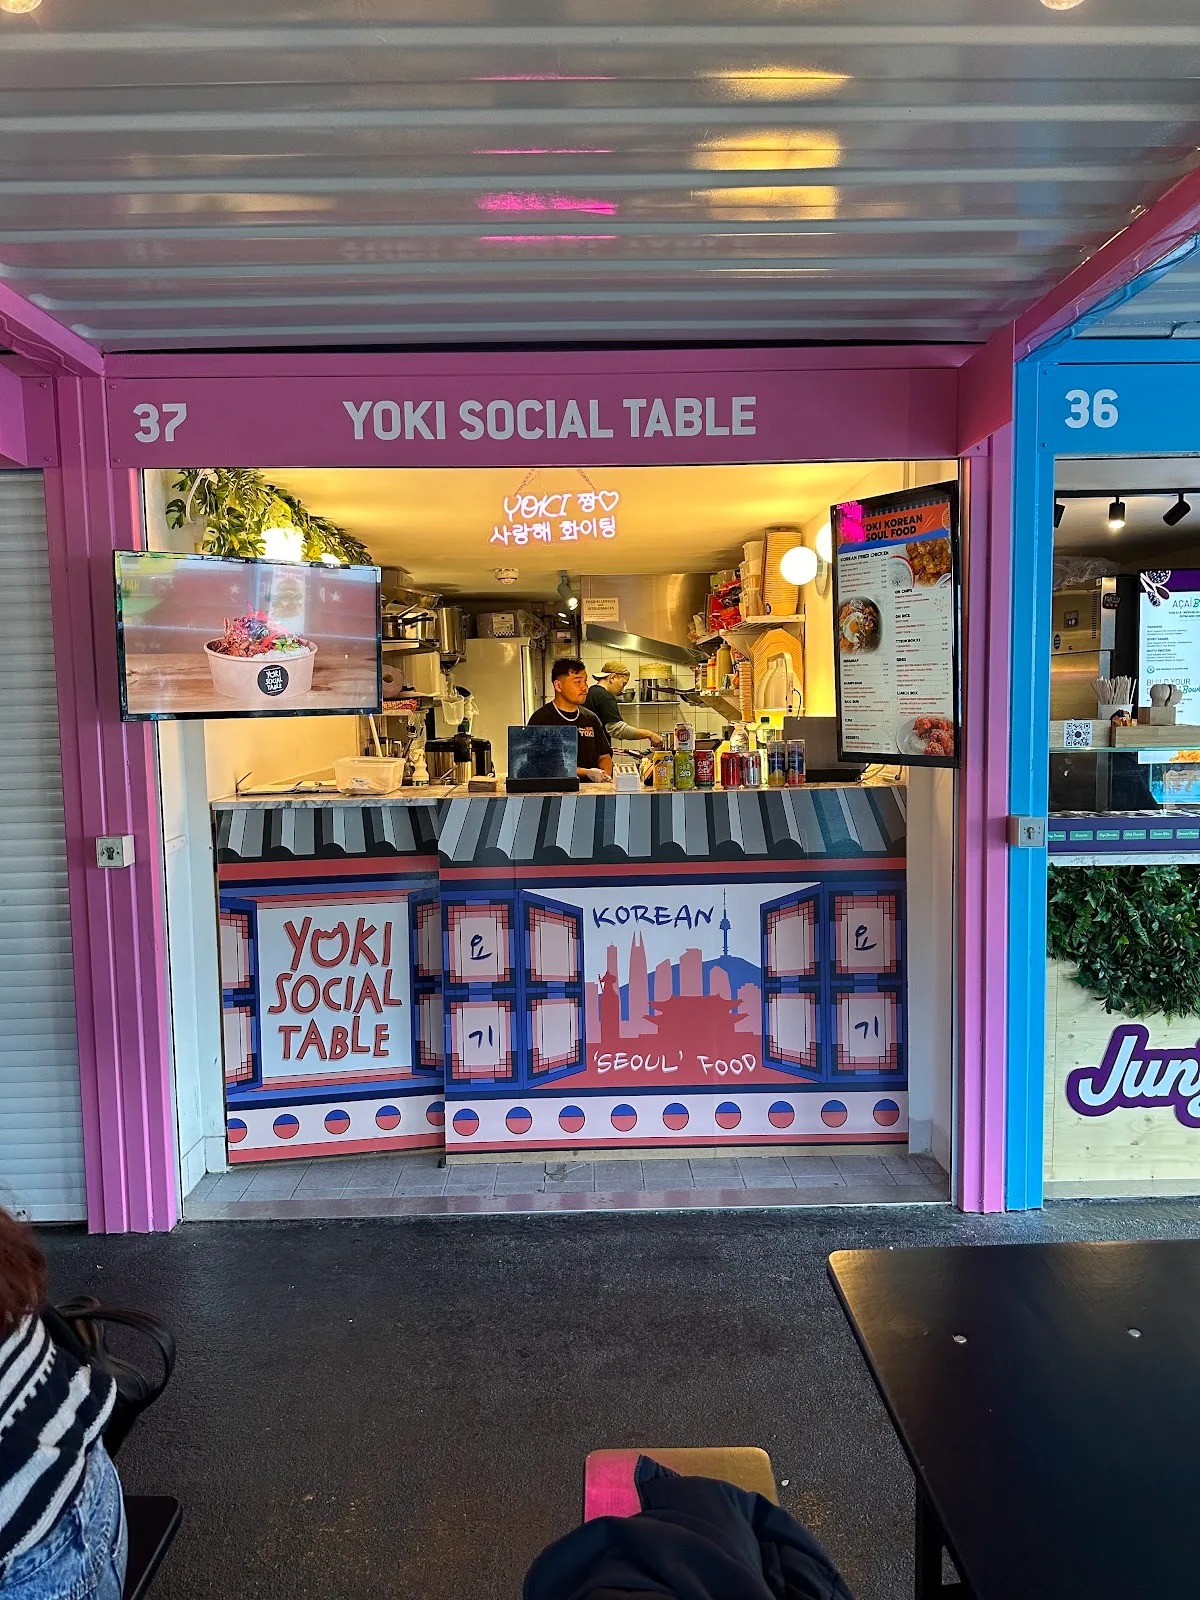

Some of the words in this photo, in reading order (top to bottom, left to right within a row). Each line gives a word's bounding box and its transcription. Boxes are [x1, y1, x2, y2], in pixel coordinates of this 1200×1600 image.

[343, 401, 446, 440] YOKI
[459, 399, 613, 440] SOCIAL
[622, 396, 757, 437] TABLE
[1065, 389, 1119, 429] 36
[133, 403, 187, 443] 37
[503, 493, 572, 522] YOKI
[489, 521, 551, 545] 사랑해
[559, 516, 616, 540] 화이팅
[863, 522, 882, 533] OKI
[884, 513, 922, 528] KOREAN
[865, 532, 888, 541] SOUL
[890, 525, 917, 538] FOOD
[1171, 678, 1191, 686] YOUR
[592, 904, 715, 930] KOREAN
[283, 916, 393, 972] YOKI
[470, 934, 492, 960] 요
[854, 925, 877, 951] 요
[267, 969, 402, 1014] SOCIAL
[278, 1016, 389, 1062] TABLE
[468, 1024, 493, 1048] 기
[855, 1015, 879, 1040] 기
[700, 1052, 757, 1076] FOOD
[1078, 1035, 1200, 1118] Jun
